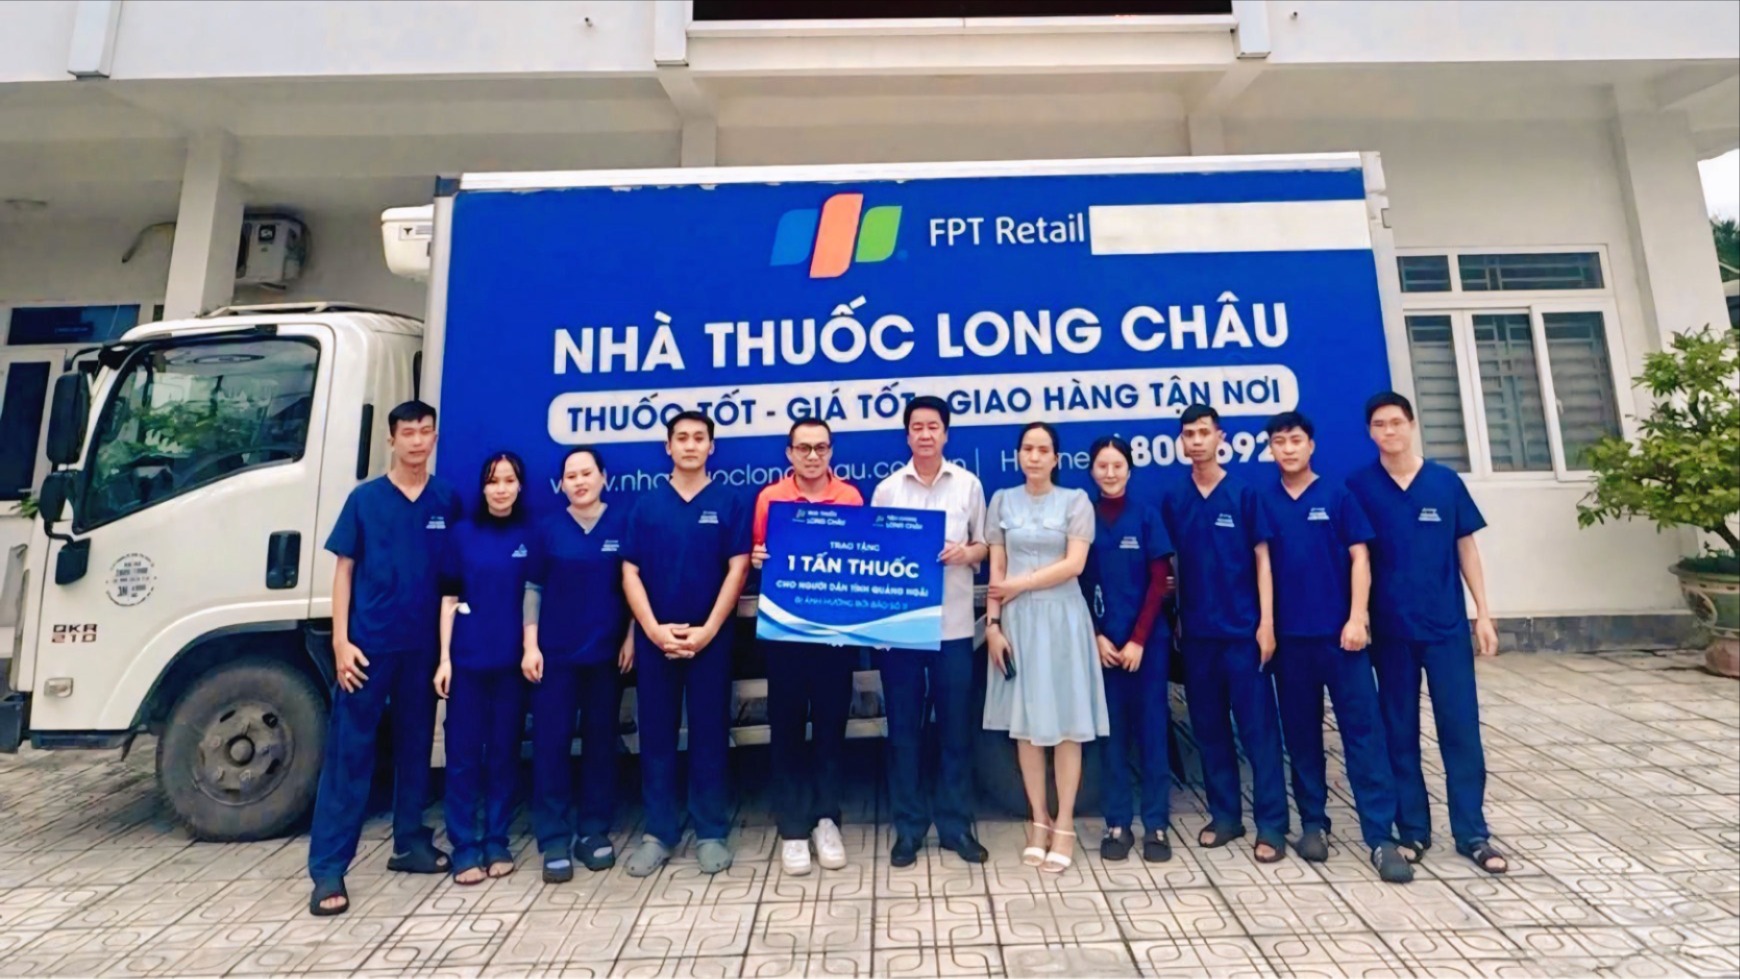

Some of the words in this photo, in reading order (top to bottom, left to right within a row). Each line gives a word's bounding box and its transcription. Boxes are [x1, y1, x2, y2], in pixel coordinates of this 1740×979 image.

[929, 217, 984, 247] FPT
[995, 213, 1085, 245] Retail
[553, 310, 685, 374] NHÀ
[704, 294, 915, 368] THUỐC
[937, 307, 1102, 358] LONG
[1121, 290, 1289, 351] CHÂU
[567, 392, 685, 432] THUỐC
[697, 388, 756, 426] TỐT
[786, 387, 847, 421] GIÁ
[948, 386, 1032, 416] GIAO
[1043, 378, 1139, 412] HÀNG
[1149, 375, 1211, 414] TẬN
[1222, 375, 1280, 404] NƠI
[787, 555, 796, 572] 1
[801, 551, 842, 574] TẤN
[847, 556, 920, 579] THUỐC
